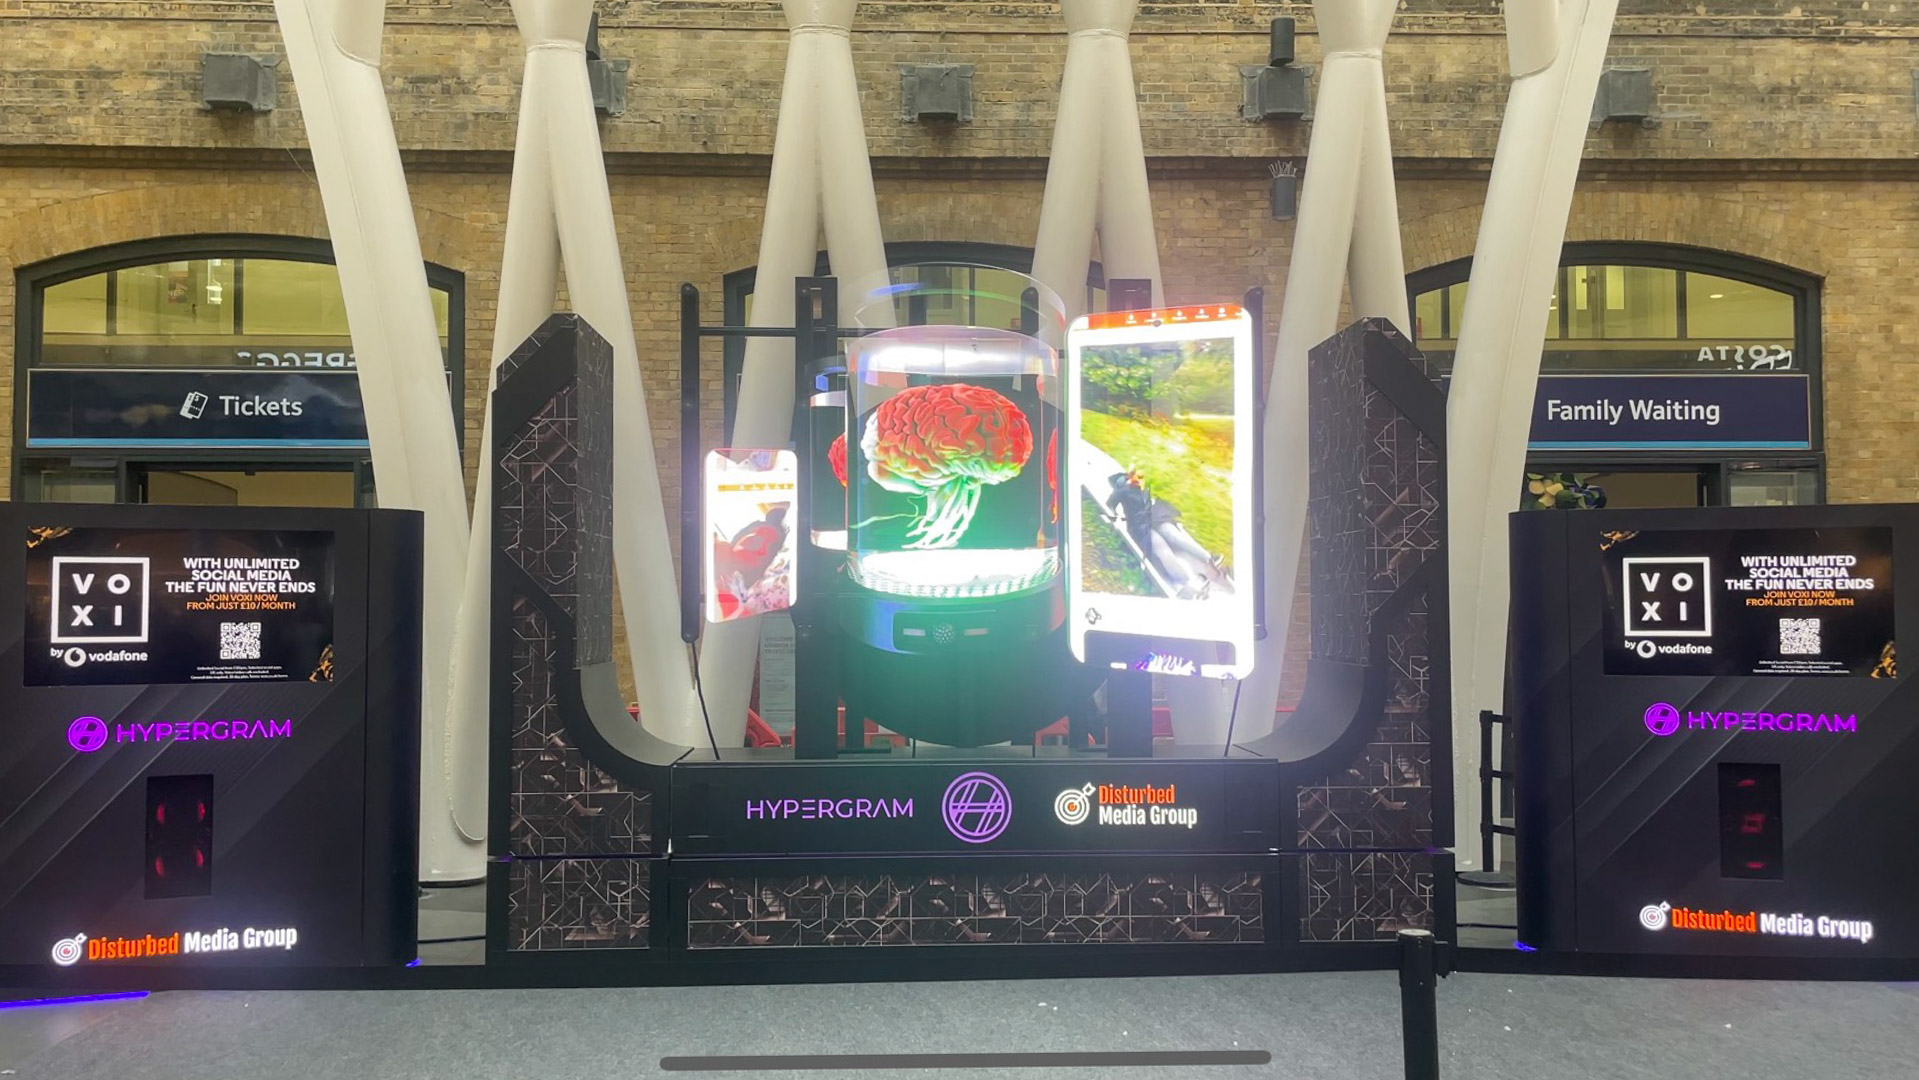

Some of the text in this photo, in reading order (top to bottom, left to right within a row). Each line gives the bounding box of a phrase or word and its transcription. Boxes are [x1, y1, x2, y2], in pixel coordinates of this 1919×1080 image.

[218, 394, 303, 416] Tickets
[1547, 399, 1721, 425] Family Waiting
[183, 557, 300, 570] WITH UNLIMITED
[1741, 555, 1857, 567] WITH UNLIMITED
[191, 570, 292, 581] SOCIAL MEDIA
[1749, 567, 1849, 578] SOCIAL MEDIA
[165, 581, 316, 593] THE FUN NEVER ENDS
[1725, 578, 1875, 590] THE FUN NEVER ENDS
[205, 594, 278, 602] JOIN VOXI NOW
[1746, 599, 1773, 607] FROM
[1774, 599, 1796, 607] JUST
[186, 602, 214, 610] FROM
[216, 602, 239, 610] JUST
[1624, 640, 1712, 654] by vodafone
[50, 647, 148, 662] by vodafone
[1687, 711, 1857, 733] HYPERGRAM
[116, 718, 292, 743] HYPERGRAM
[1098, 783, 1176, 804] Disturbed
[746, 798, 914, 820] HYPERGRAM
[1098, 804, 1198, 829] Media Group
[1671, 906, 1873, 944] Disturbed Media Group
[88, 927, 298, 960] Disturbed Media Group
